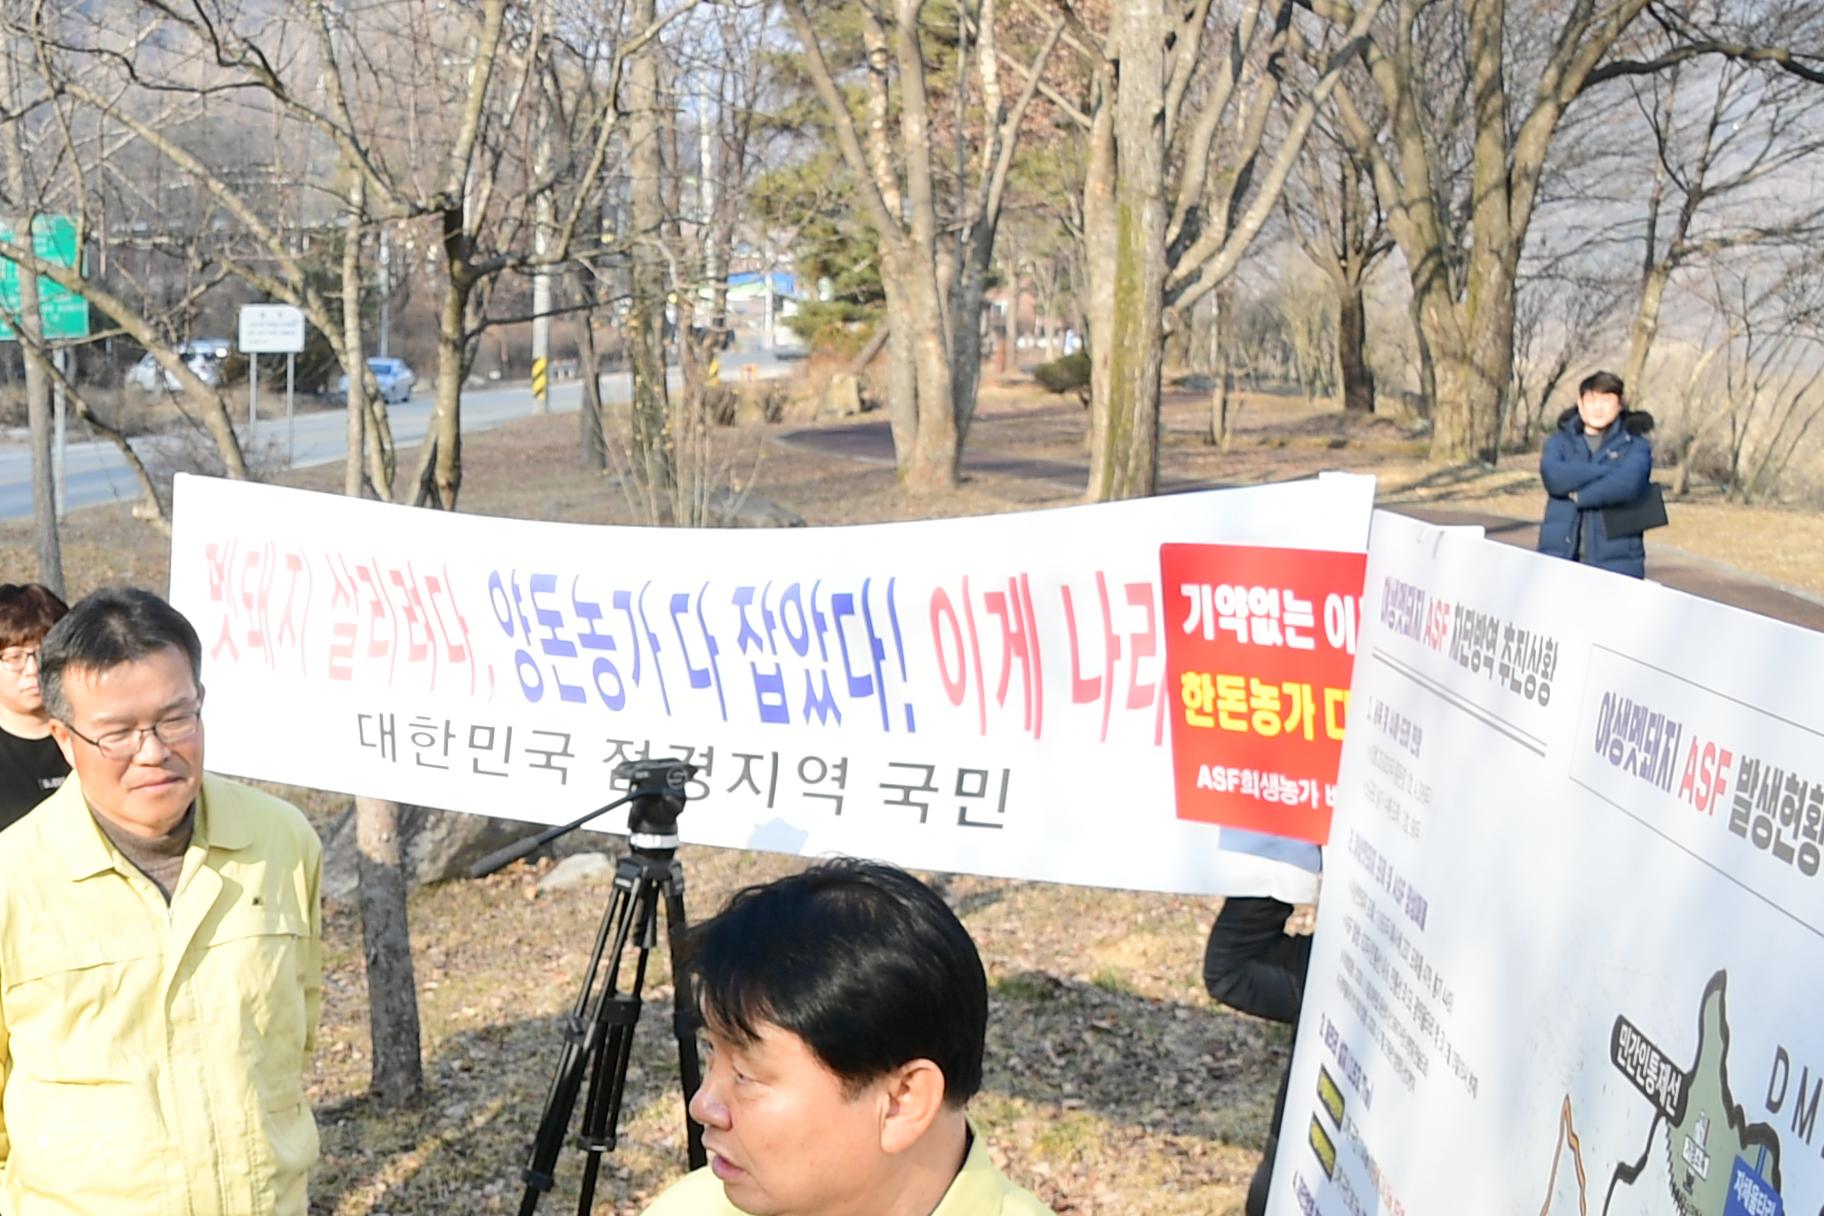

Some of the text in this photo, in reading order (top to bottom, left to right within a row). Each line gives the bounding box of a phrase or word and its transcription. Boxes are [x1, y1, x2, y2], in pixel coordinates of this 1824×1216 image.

[206, 537, 312, 676] 멧돼지
[488, 567, 671, 717] 양돈농가
[671, 580, 728, 722] 다
[732, 575, 916, 734] 잡았다!
[929, 571, 1044, 740] 이게
[1180, 583, 1364, 656] 기약없는 이
[1380, 576, 1559, 707] 야생멧돼지 ASF 차단방역 추진상황
[1180, 671, 1316, 741] 한돈농가
[357, 711, 575, 786] 대한민국
[878, 759, 1012, 831] 국민
[1196, 764, 1319, 810] ASF희생농가
[1595, 691, 1824, 878] 야생멧돼지 ASF 발생현황
[1616, 1024, 1682, 1118] 민간인통제선
[1765, 1044, 1824, 1160] DM
